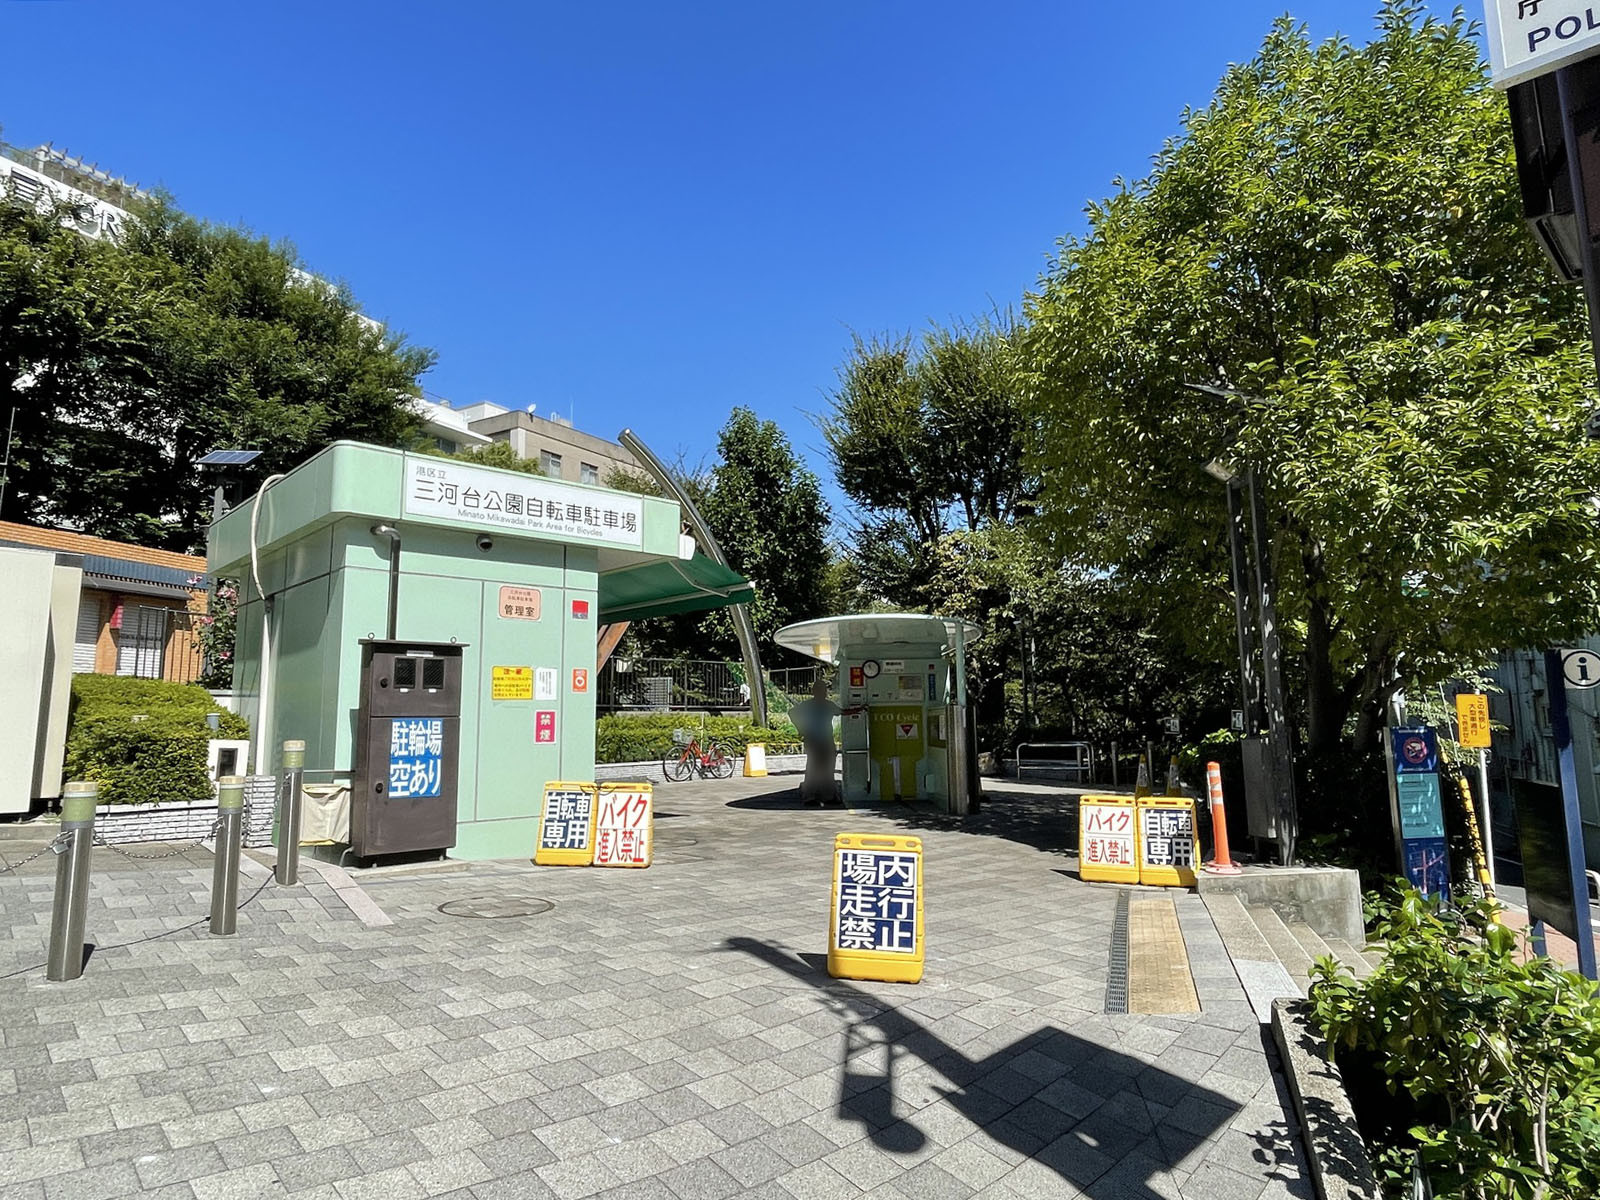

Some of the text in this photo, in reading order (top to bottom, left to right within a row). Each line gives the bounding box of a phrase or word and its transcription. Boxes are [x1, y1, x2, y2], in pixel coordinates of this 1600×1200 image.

[416, 465, 446, 480] 港区立
[414, 479, 637, 533] 三河台公園自転車駐車場
[457, 508, 603, 537] Minato Mikawadai Park Area for Bicycles
[504, 604, 535, 617] 管理室
[390, 720, 443, 756] 駐輪場
[388, 759, 441, 797] 空あり
[546, 792, 591, 820] 自転車
[600, 794, 648, 828] バイク
[1087, 808, 1130, 832] バイク
[543, 820, 589, 849] 専用
[1146, 810, 1192, 837] 自転車
[597, 829, 645, 863] 進入禁止
[1087, 839, 1130, 864] 進入禁止
[1147, 838, 1193, 866] 専用
[843, 853, 914, 887] 場内
[841, 885, 913, 919] 走行
[840, 917, 913, 952] 禁止
